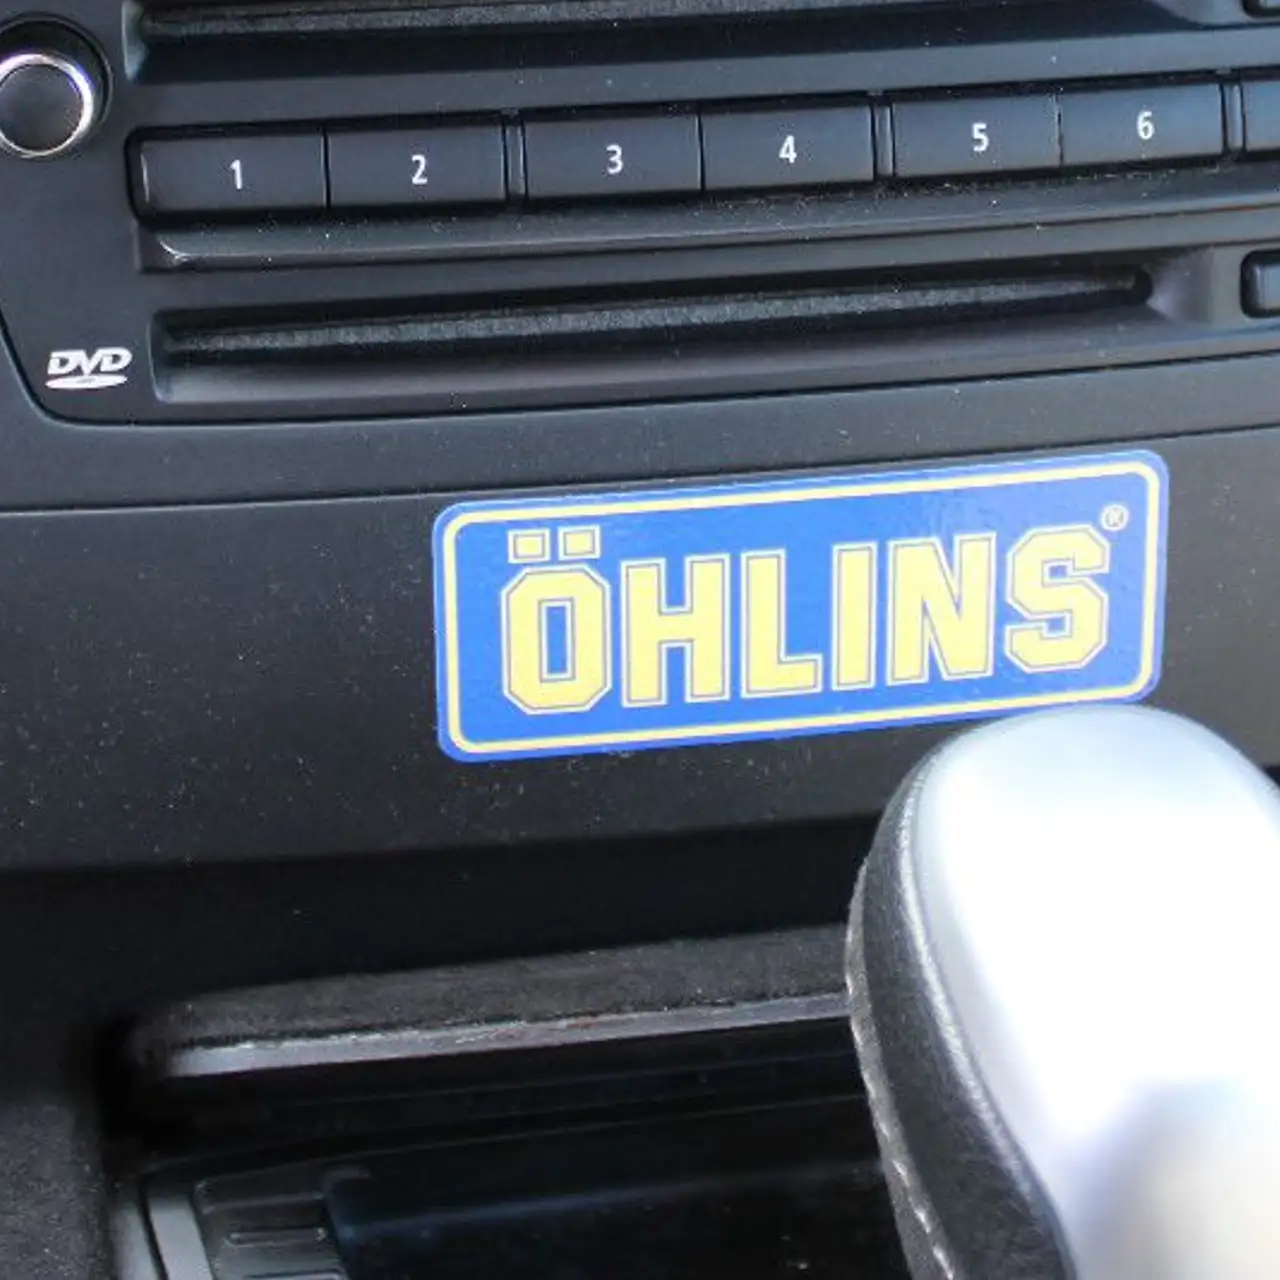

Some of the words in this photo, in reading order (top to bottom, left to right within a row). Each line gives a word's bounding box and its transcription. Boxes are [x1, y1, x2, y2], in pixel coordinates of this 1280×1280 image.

[973, 123, 988, 151] 5
[1138, 112, 1154, 139] 6
[607, 145, 622, 173] 3
[780, 136, 796, 163] 4
[231, 160, 241, 189] 1
[412, 155, 427, 184] 2
[47, 346, 133, 377] DVD
[499, 523, 1111, 716] ÖHLINS
